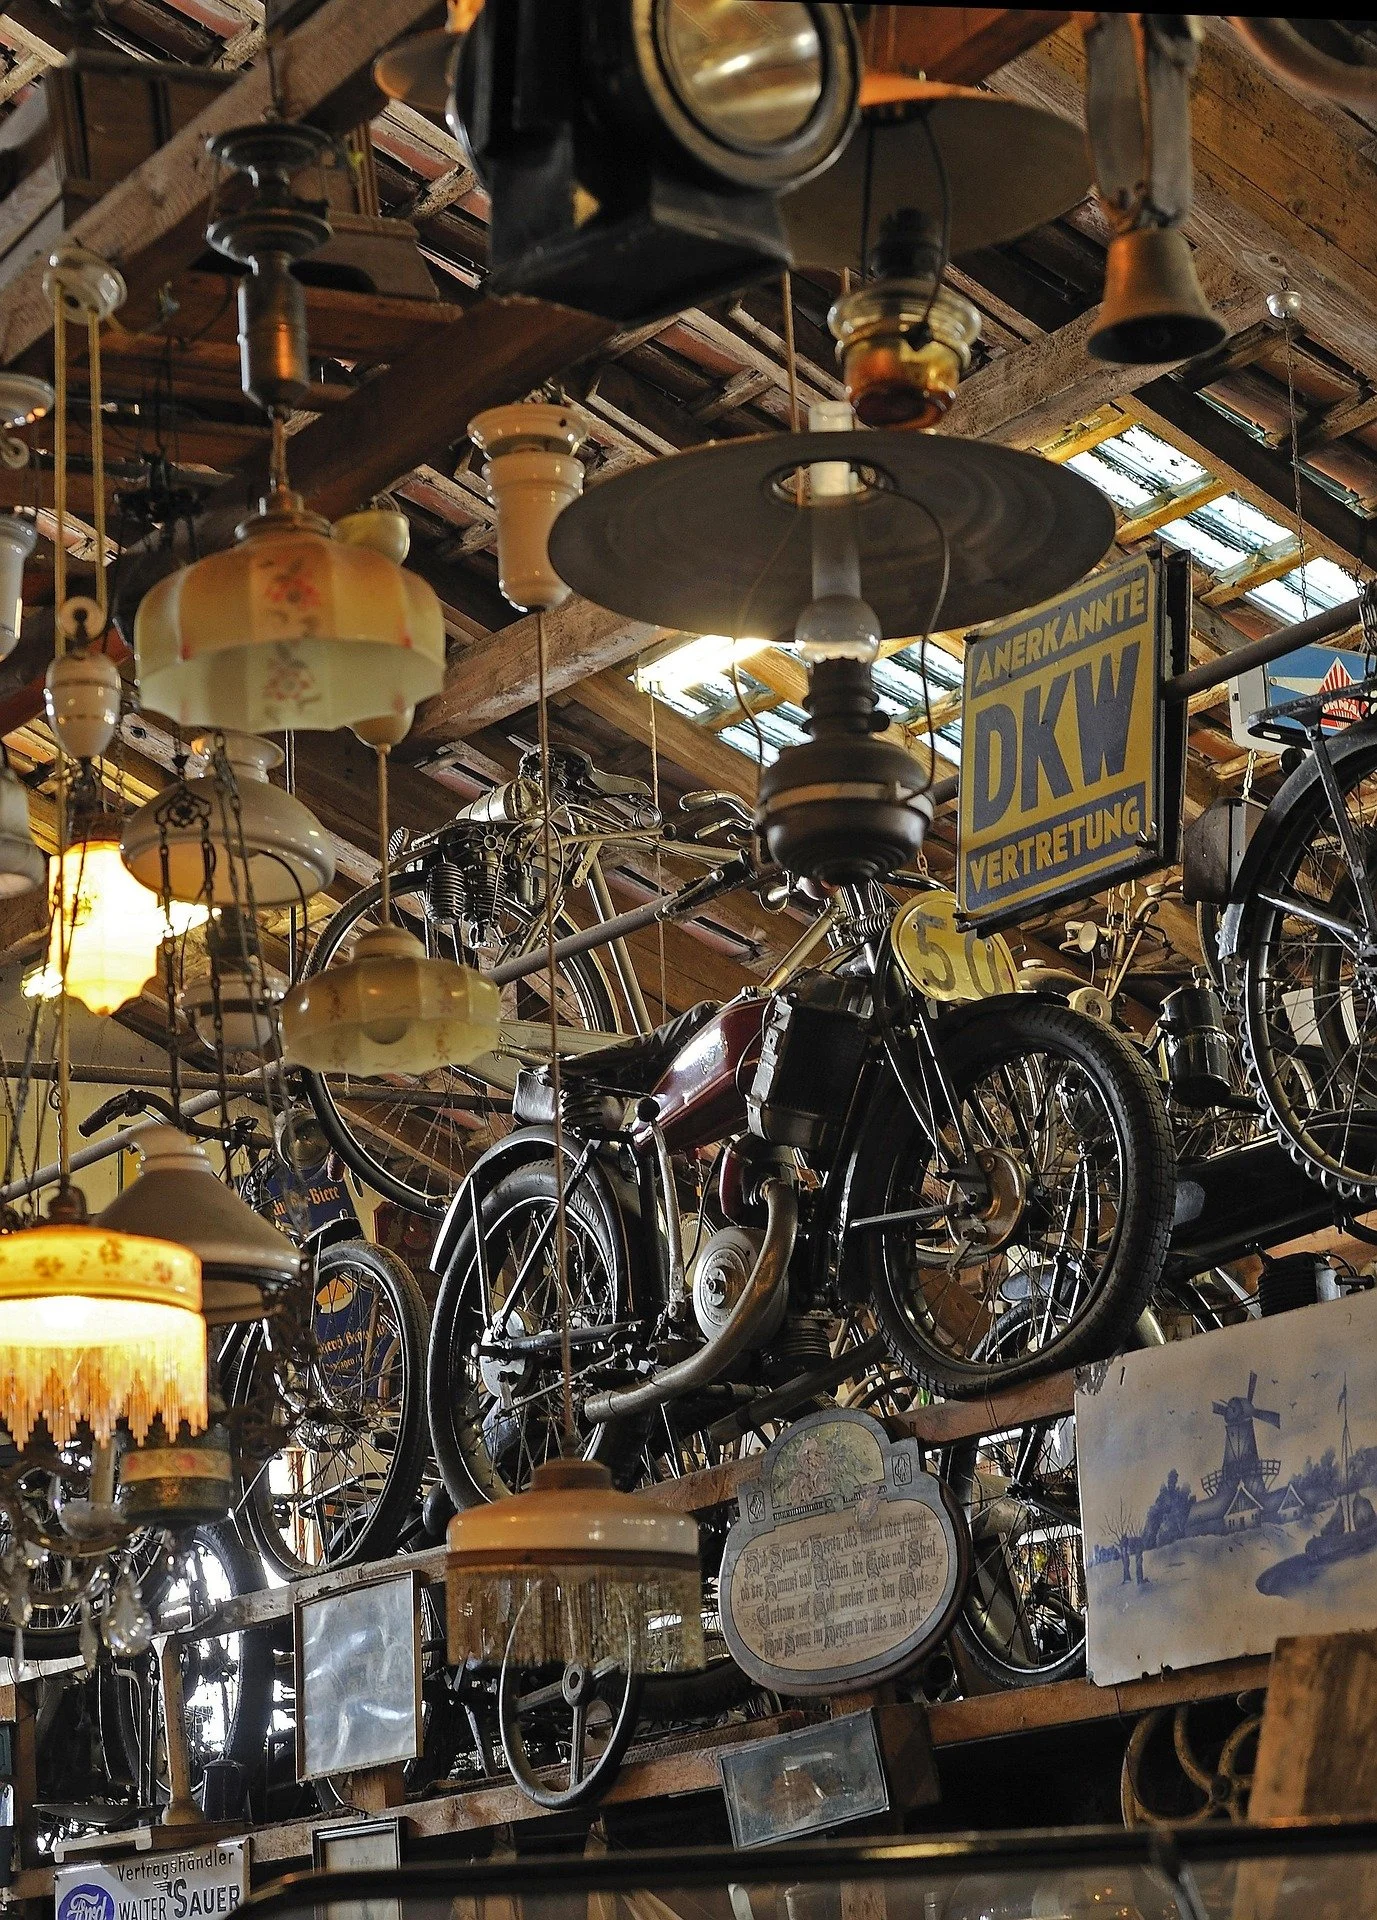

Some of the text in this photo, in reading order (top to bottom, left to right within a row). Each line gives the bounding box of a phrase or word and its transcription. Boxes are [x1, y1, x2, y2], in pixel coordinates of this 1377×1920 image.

[974, 576, 1147, 688] ANERKANNTE
[972, 641, 1141, 834] DKW
[969, 795, 1141, 895] VERTRETUNG
[116, 1848, 235, 1882] Vertragshändler
[173, 1878, 240, 1919] SAUER
